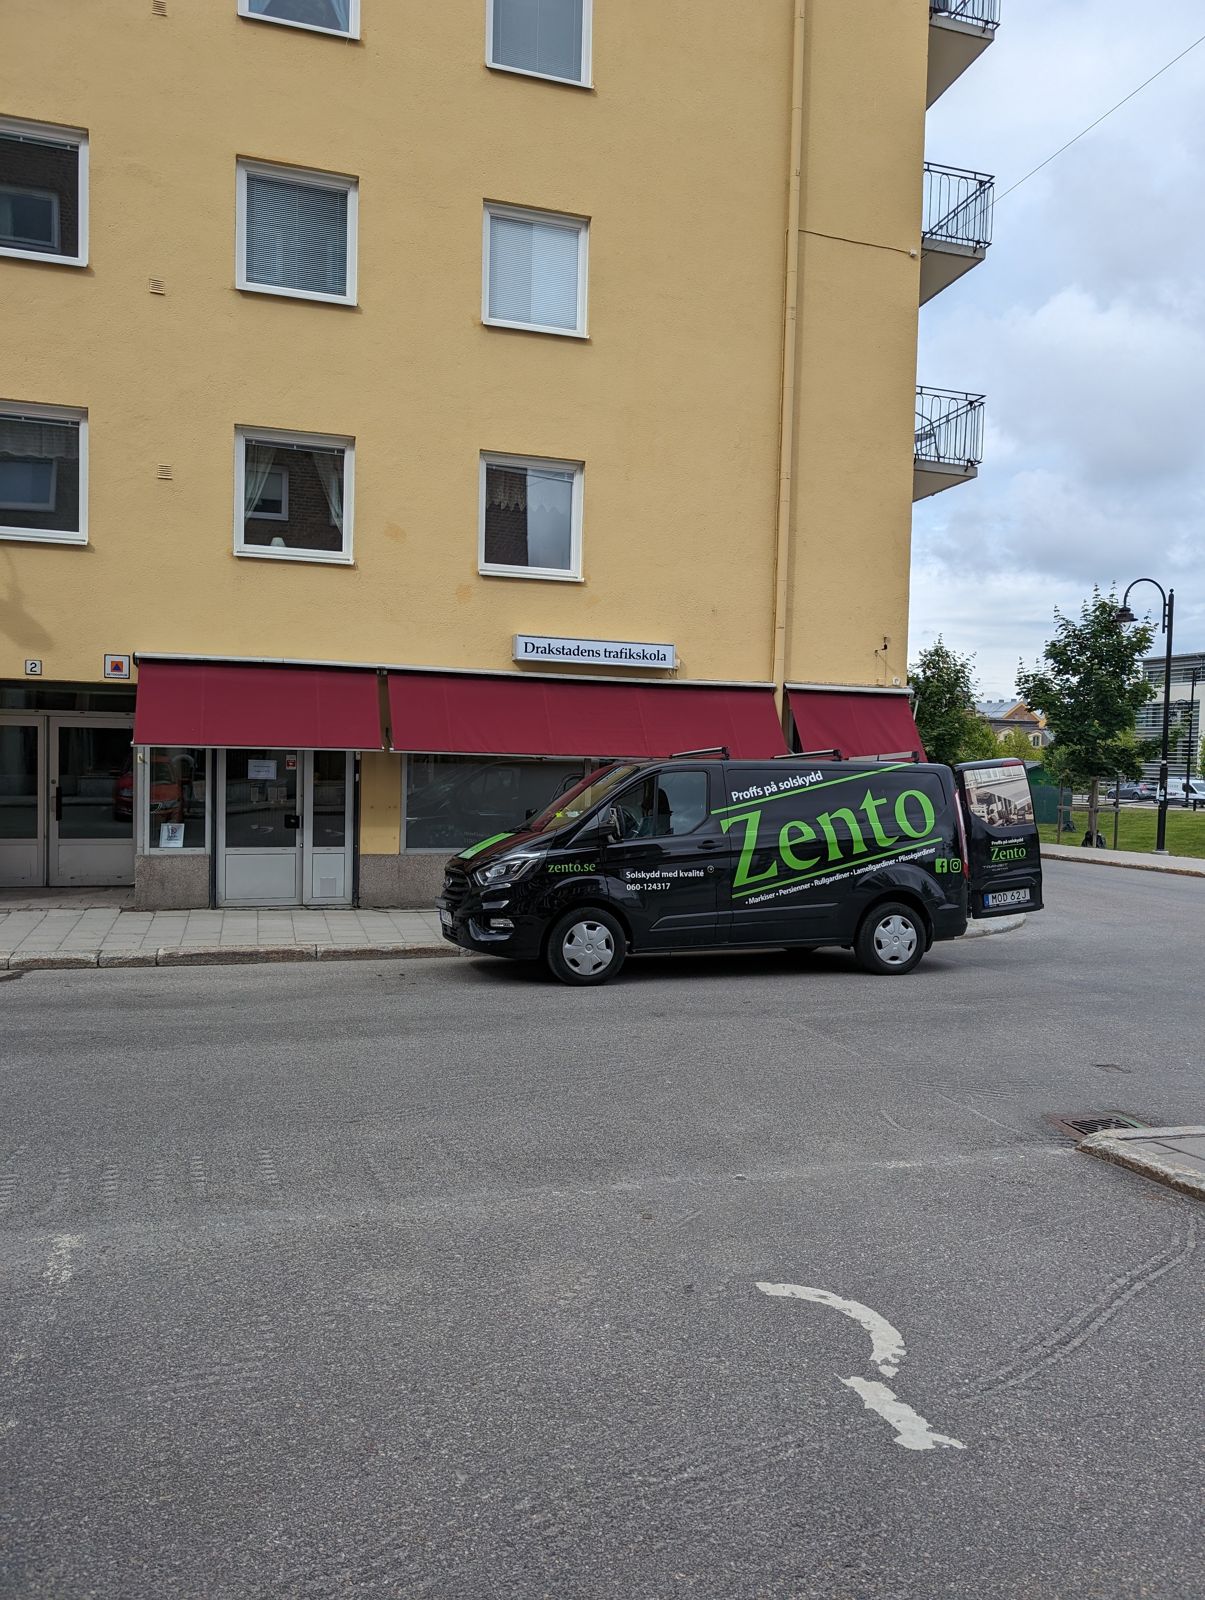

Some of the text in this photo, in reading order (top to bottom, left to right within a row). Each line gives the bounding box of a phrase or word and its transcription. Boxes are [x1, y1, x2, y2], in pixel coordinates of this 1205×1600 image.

[523, 641, 667, 662] Drakstadens trafikskola
[29, 662, 37, 673] 2
[731, 770, 823, 802] Proffs på solskydd
[719, 788, 935, 888] Zento
[991, 847, 1027, 861] Zento
[547, 862, 596, 873] zento.se
[626, 869, 705, 880] Solskydd med kvalité
[626, 882, 671, 892] 060-124317
[748, 892, 776, 905] Markiser
[778, 882, 811, 897] Persienner
[813, 871, 850, 887] Rullgardiner
[852, 858, 896, 876] Lamellgardiner
[991, 892, 1008, 904] MOD
[1010, 890, 1027, 901] 62J
